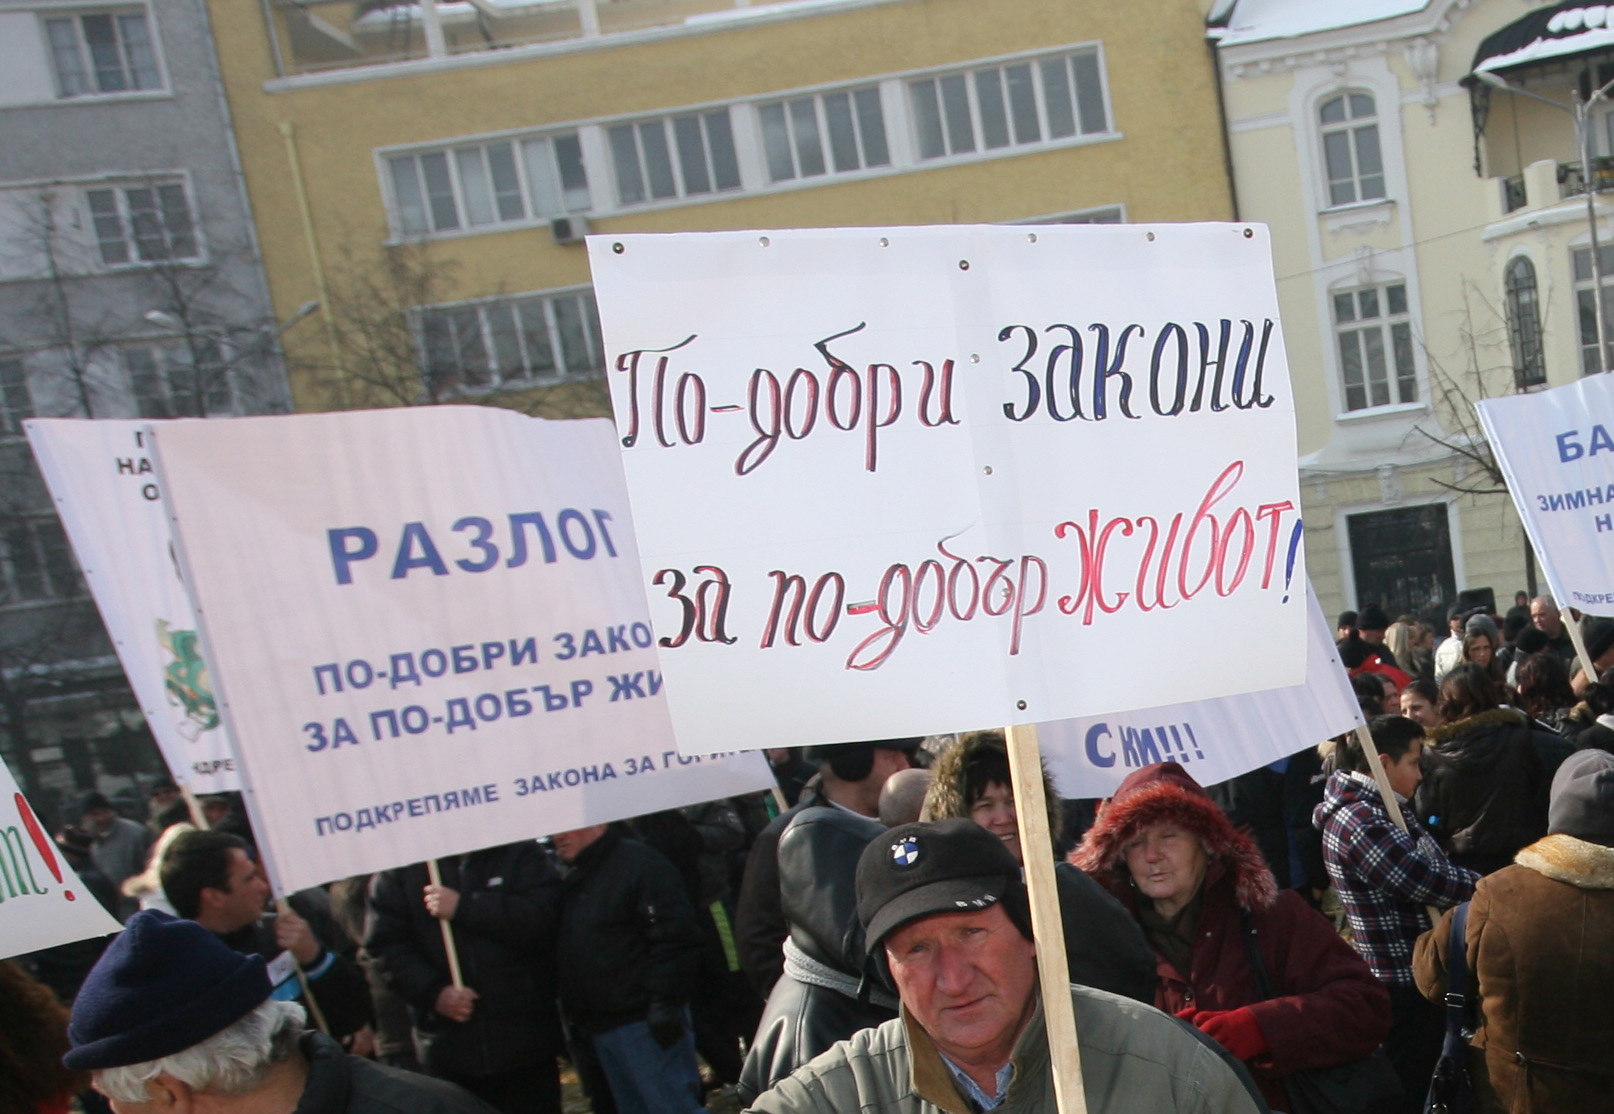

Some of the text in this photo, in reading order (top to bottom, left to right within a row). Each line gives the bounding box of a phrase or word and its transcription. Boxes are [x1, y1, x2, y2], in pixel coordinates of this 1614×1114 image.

[997, 317, 1276, 423] закони
[760, 524, 1048, 673] по-добър
[312, 619, 652, 696] ПО-ДОБРИ ЗАКО
[302, 668, 664, 754] ЗА ПО-ДОБЪР ЖИ
[314, 783, 500, 837] ПОДКРЕПЯМЕ
[513, 762, 617, 798] ЗАКОНА
[623, 755, 656, 776] ЗА
